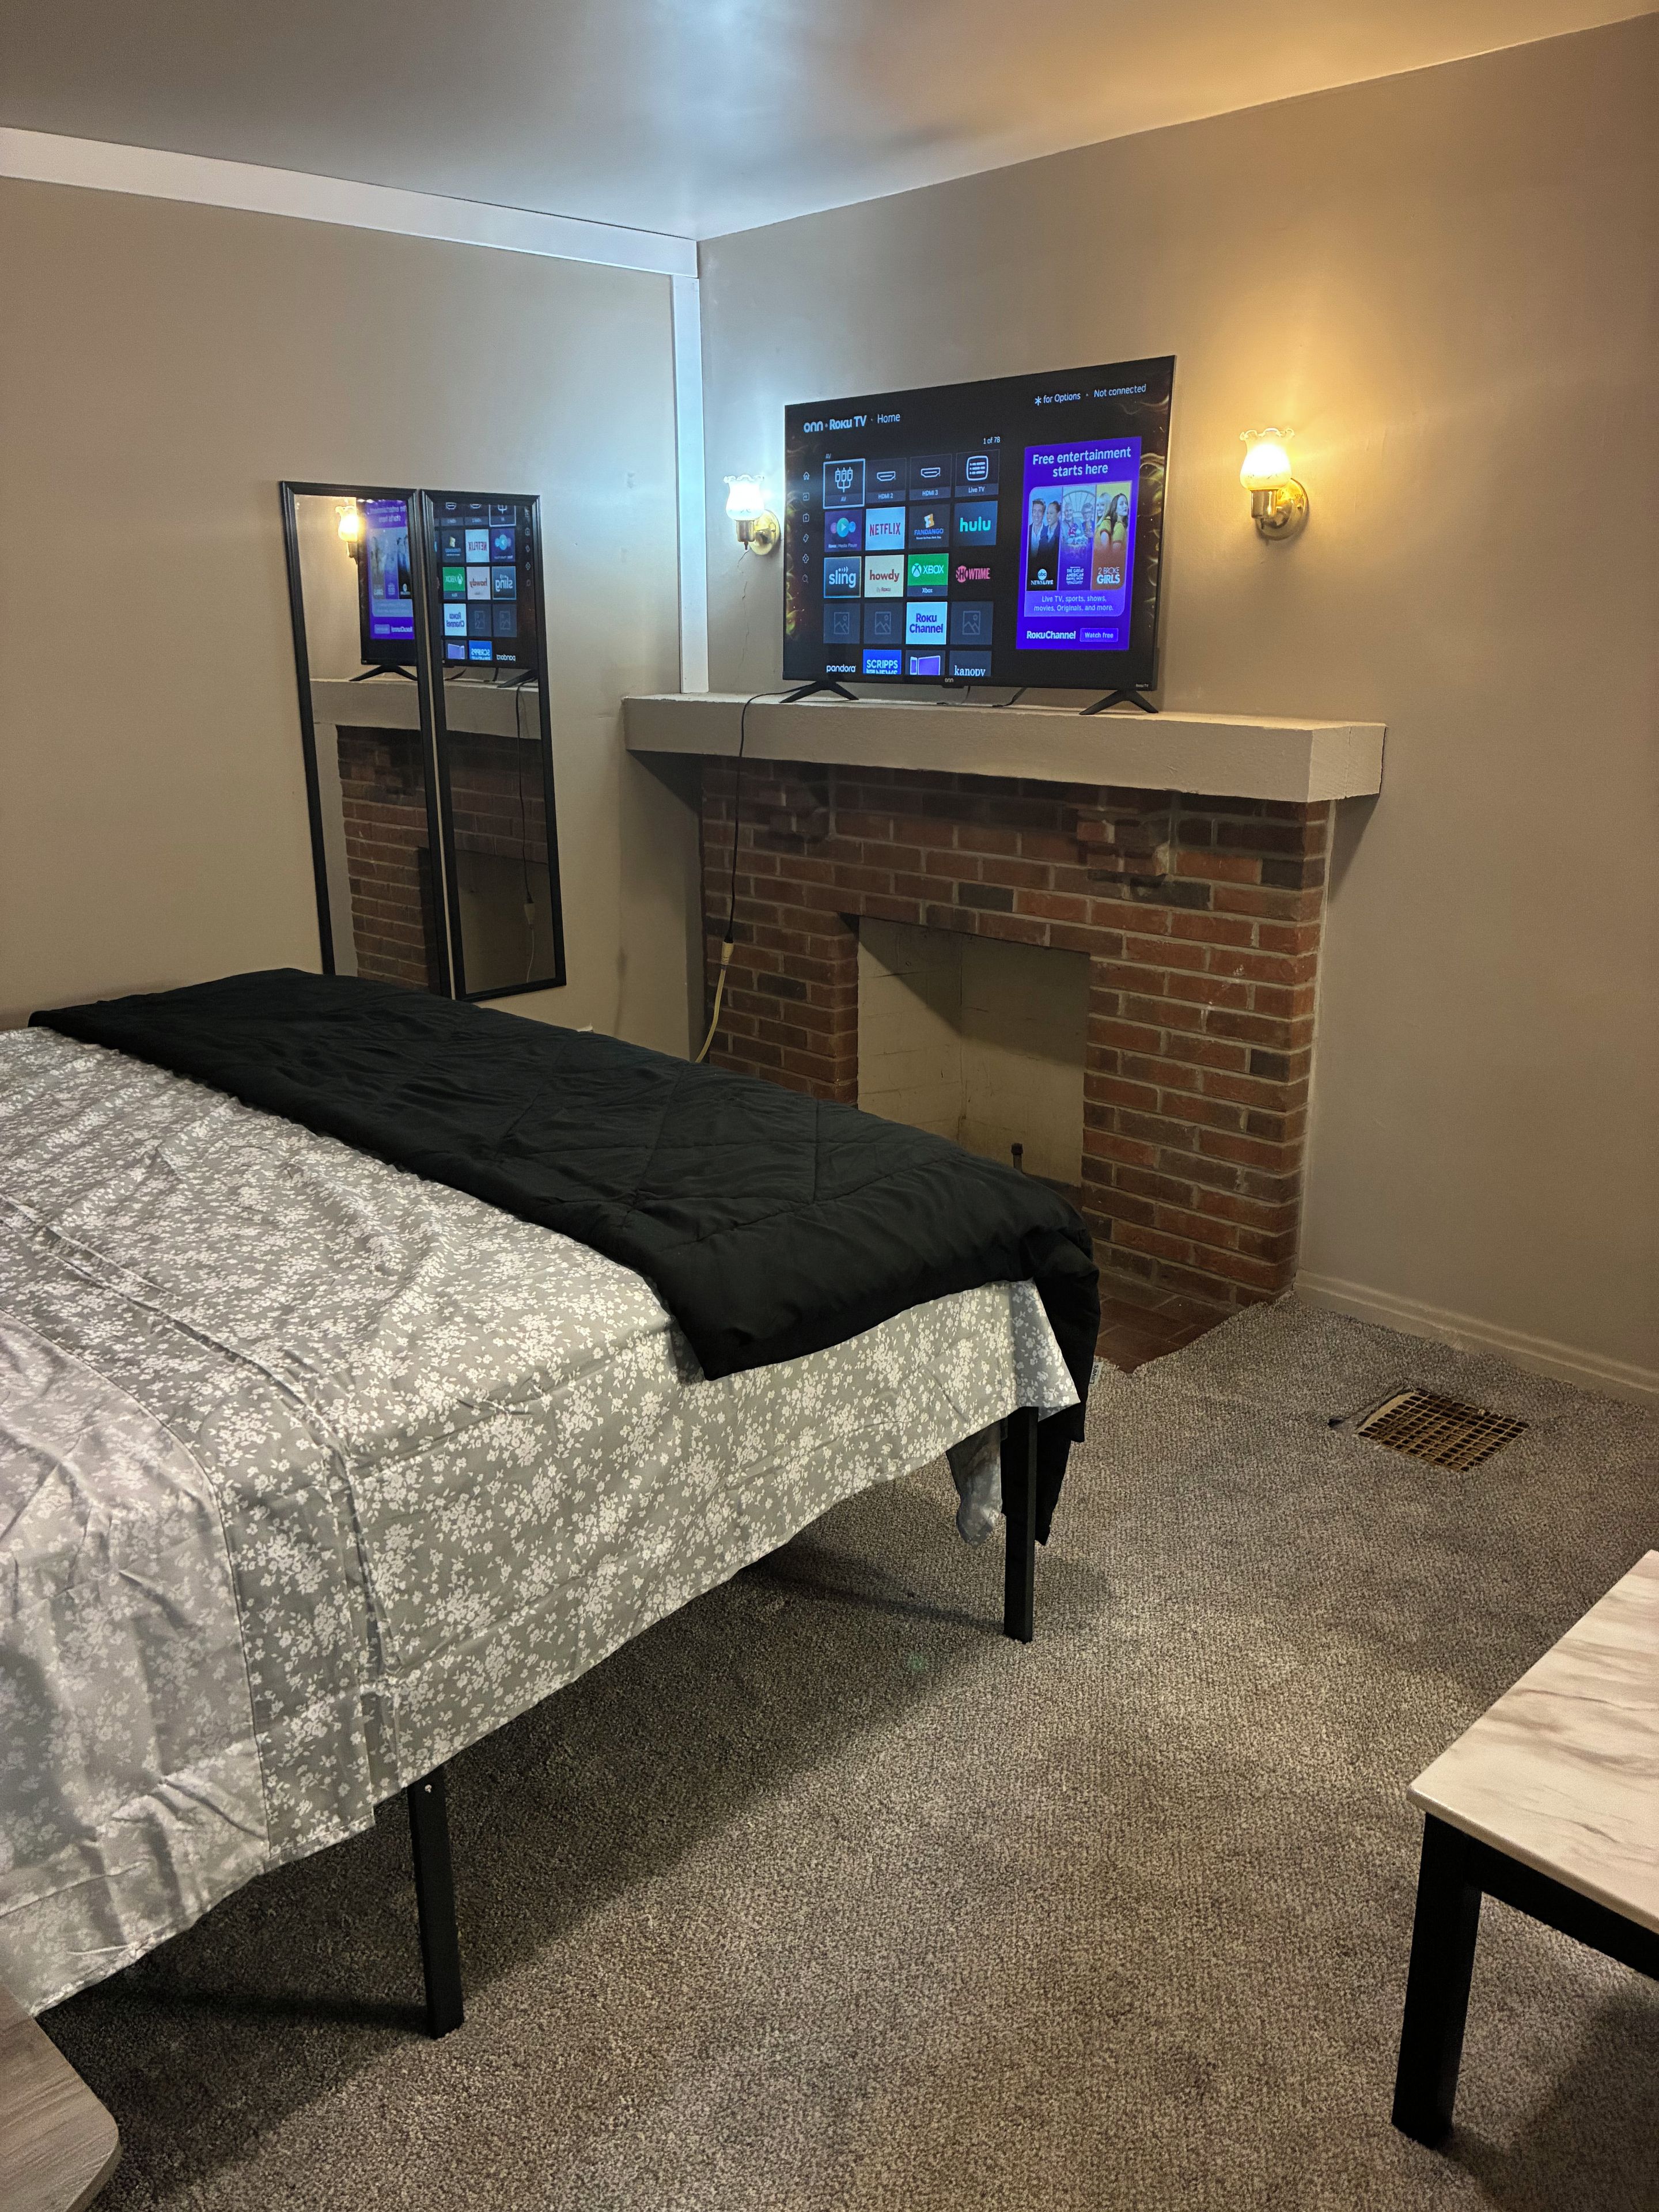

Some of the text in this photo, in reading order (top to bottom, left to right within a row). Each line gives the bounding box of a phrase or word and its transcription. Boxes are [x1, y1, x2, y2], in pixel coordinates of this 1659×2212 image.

[1094, 384, 1146, 397] Not connected
[1043, 392, 1081, 404] for Options
[804, 415, 867, 433] onn Roku TV
[877, 414, 900, 423] Home
[1033, 446, 1131, 465] Free entertainment
[1053, 464, 1108, 478] starts here
[870, 522, 901, 536] NETFLIX
[960, 516, 991, 532] hulu
[869, 569, 900, 582] howdy
[923, 565, 944, 574] XBOX
[956, 565, 991, 582] SHOWTIME
[829, 568, 856, 588] sling
[1097, 574, 1120, 584] GIRLS
[916, 613, 937, 622] Roku
[910, 624, 944, 633] Channel
[826, 664, 856, 673] pandora
[866, 660, 898, 669] SCRIPPS
